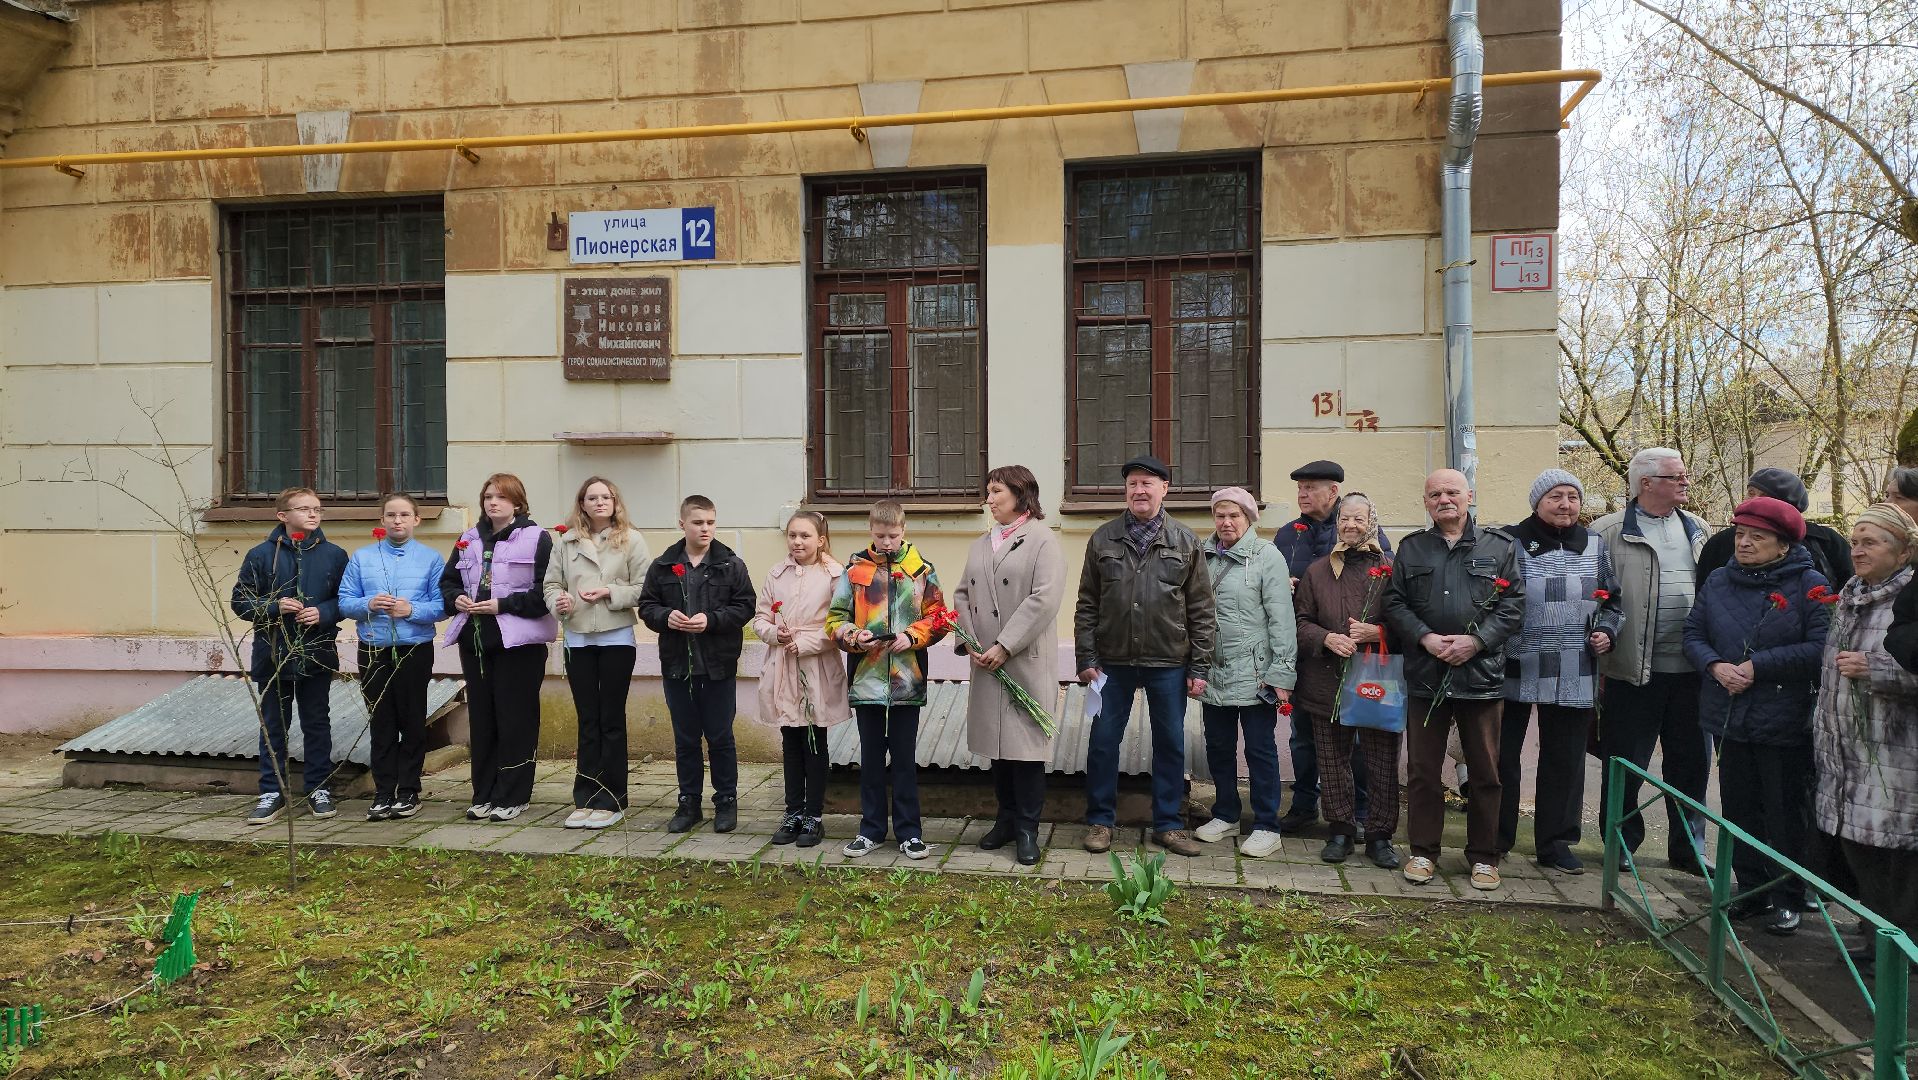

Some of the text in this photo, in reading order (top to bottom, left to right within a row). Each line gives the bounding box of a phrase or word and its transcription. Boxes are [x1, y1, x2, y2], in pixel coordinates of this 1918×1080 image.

[604, 217, 646, 232] улица
[685, 218, 711, 247] 12
[576, 237, 677, 258] Пионерская
[1511, 241, 1533, 256] ПГ
[1525, 272, 1540, 283] 13
[581, 288, 606, 296] ЭТОМ
[610, 288, 636, 297] ДОМЕ
[640, 287, 662, 296] ЖИЛ
[598, 301, 661, 317] Егоров
[598, 319, 661, 332] Николай
[598, 336, 661, 349] Михайлович
[586, 357, 647, 367] СОЦИАЛИСТИЧЕСКОГО
[649, 357, 667, 368] ТРУДА
[1311, 392, 1334, 417] 13
